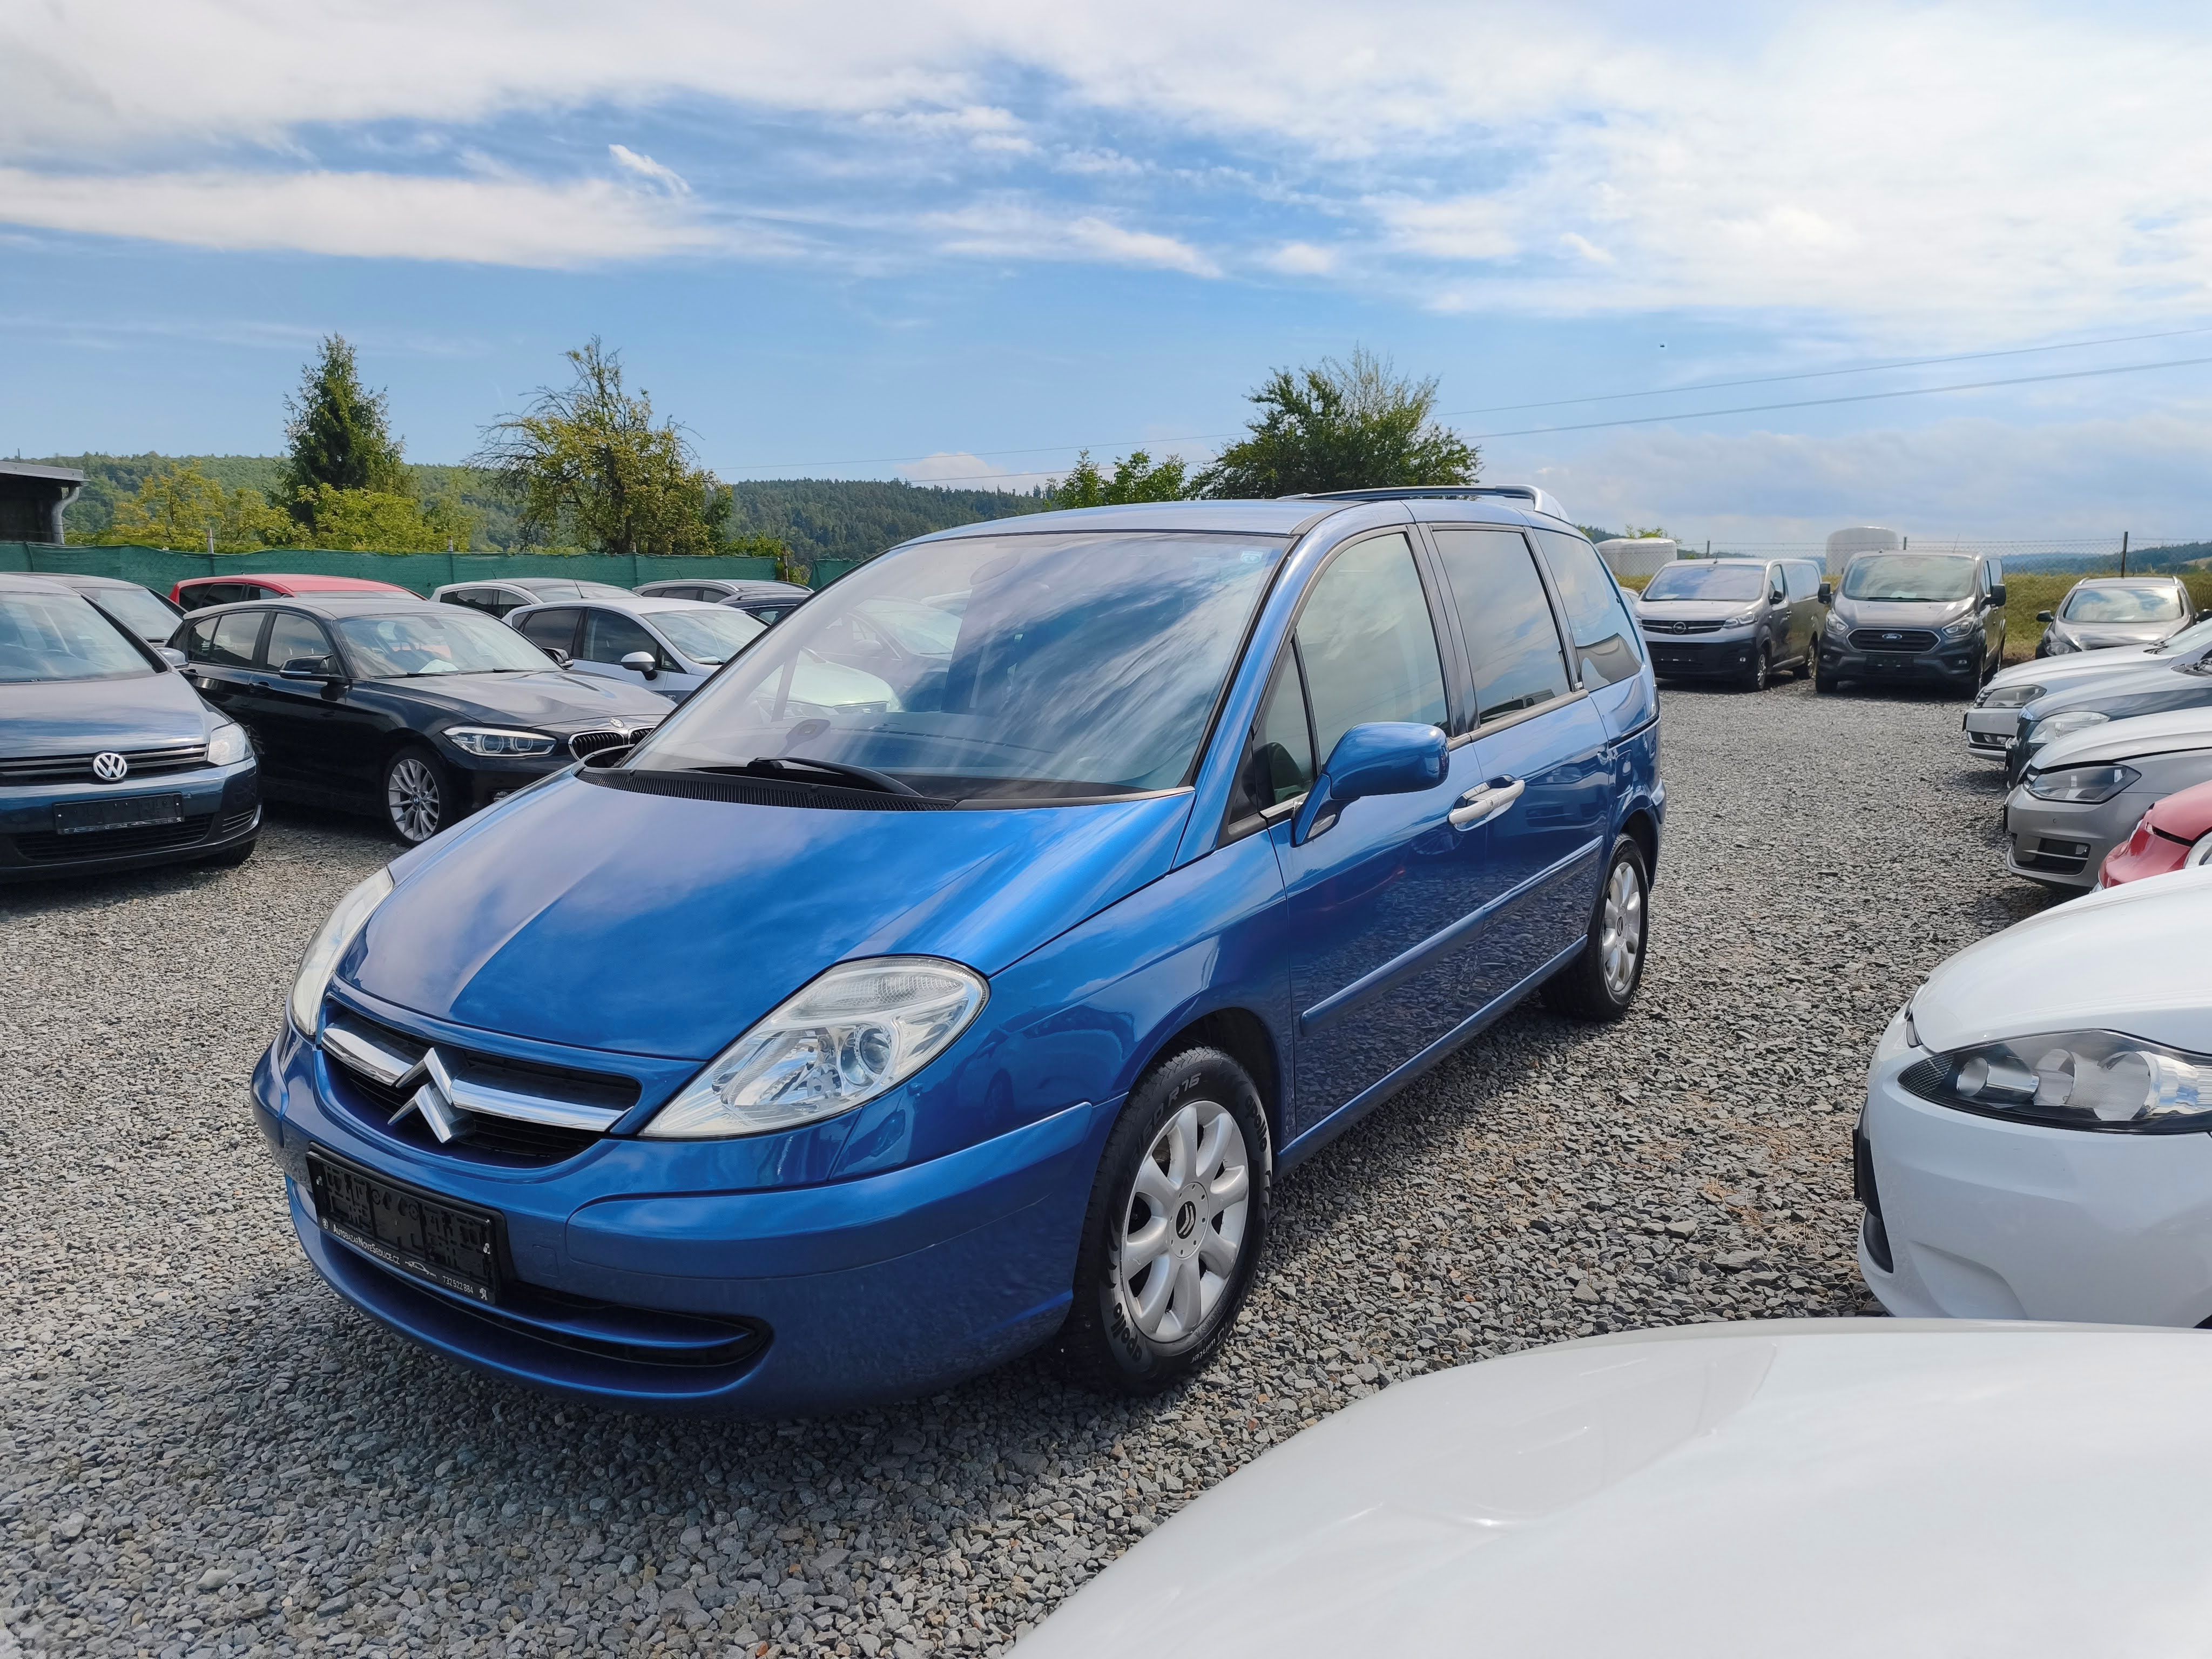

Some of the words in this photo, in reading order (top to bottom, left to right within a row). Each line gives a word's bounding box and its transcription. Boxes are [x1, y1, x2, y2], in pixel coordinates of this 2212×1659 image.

[1168, 1087, 1179, 1107] R
[1182, 1073, 1202, 1092] 16
[1244, 1094, 1267, 1153] apollo
[1110, 1302, 1143, 1363] apollo
[1190, 1338, 1216, 1364] winter
